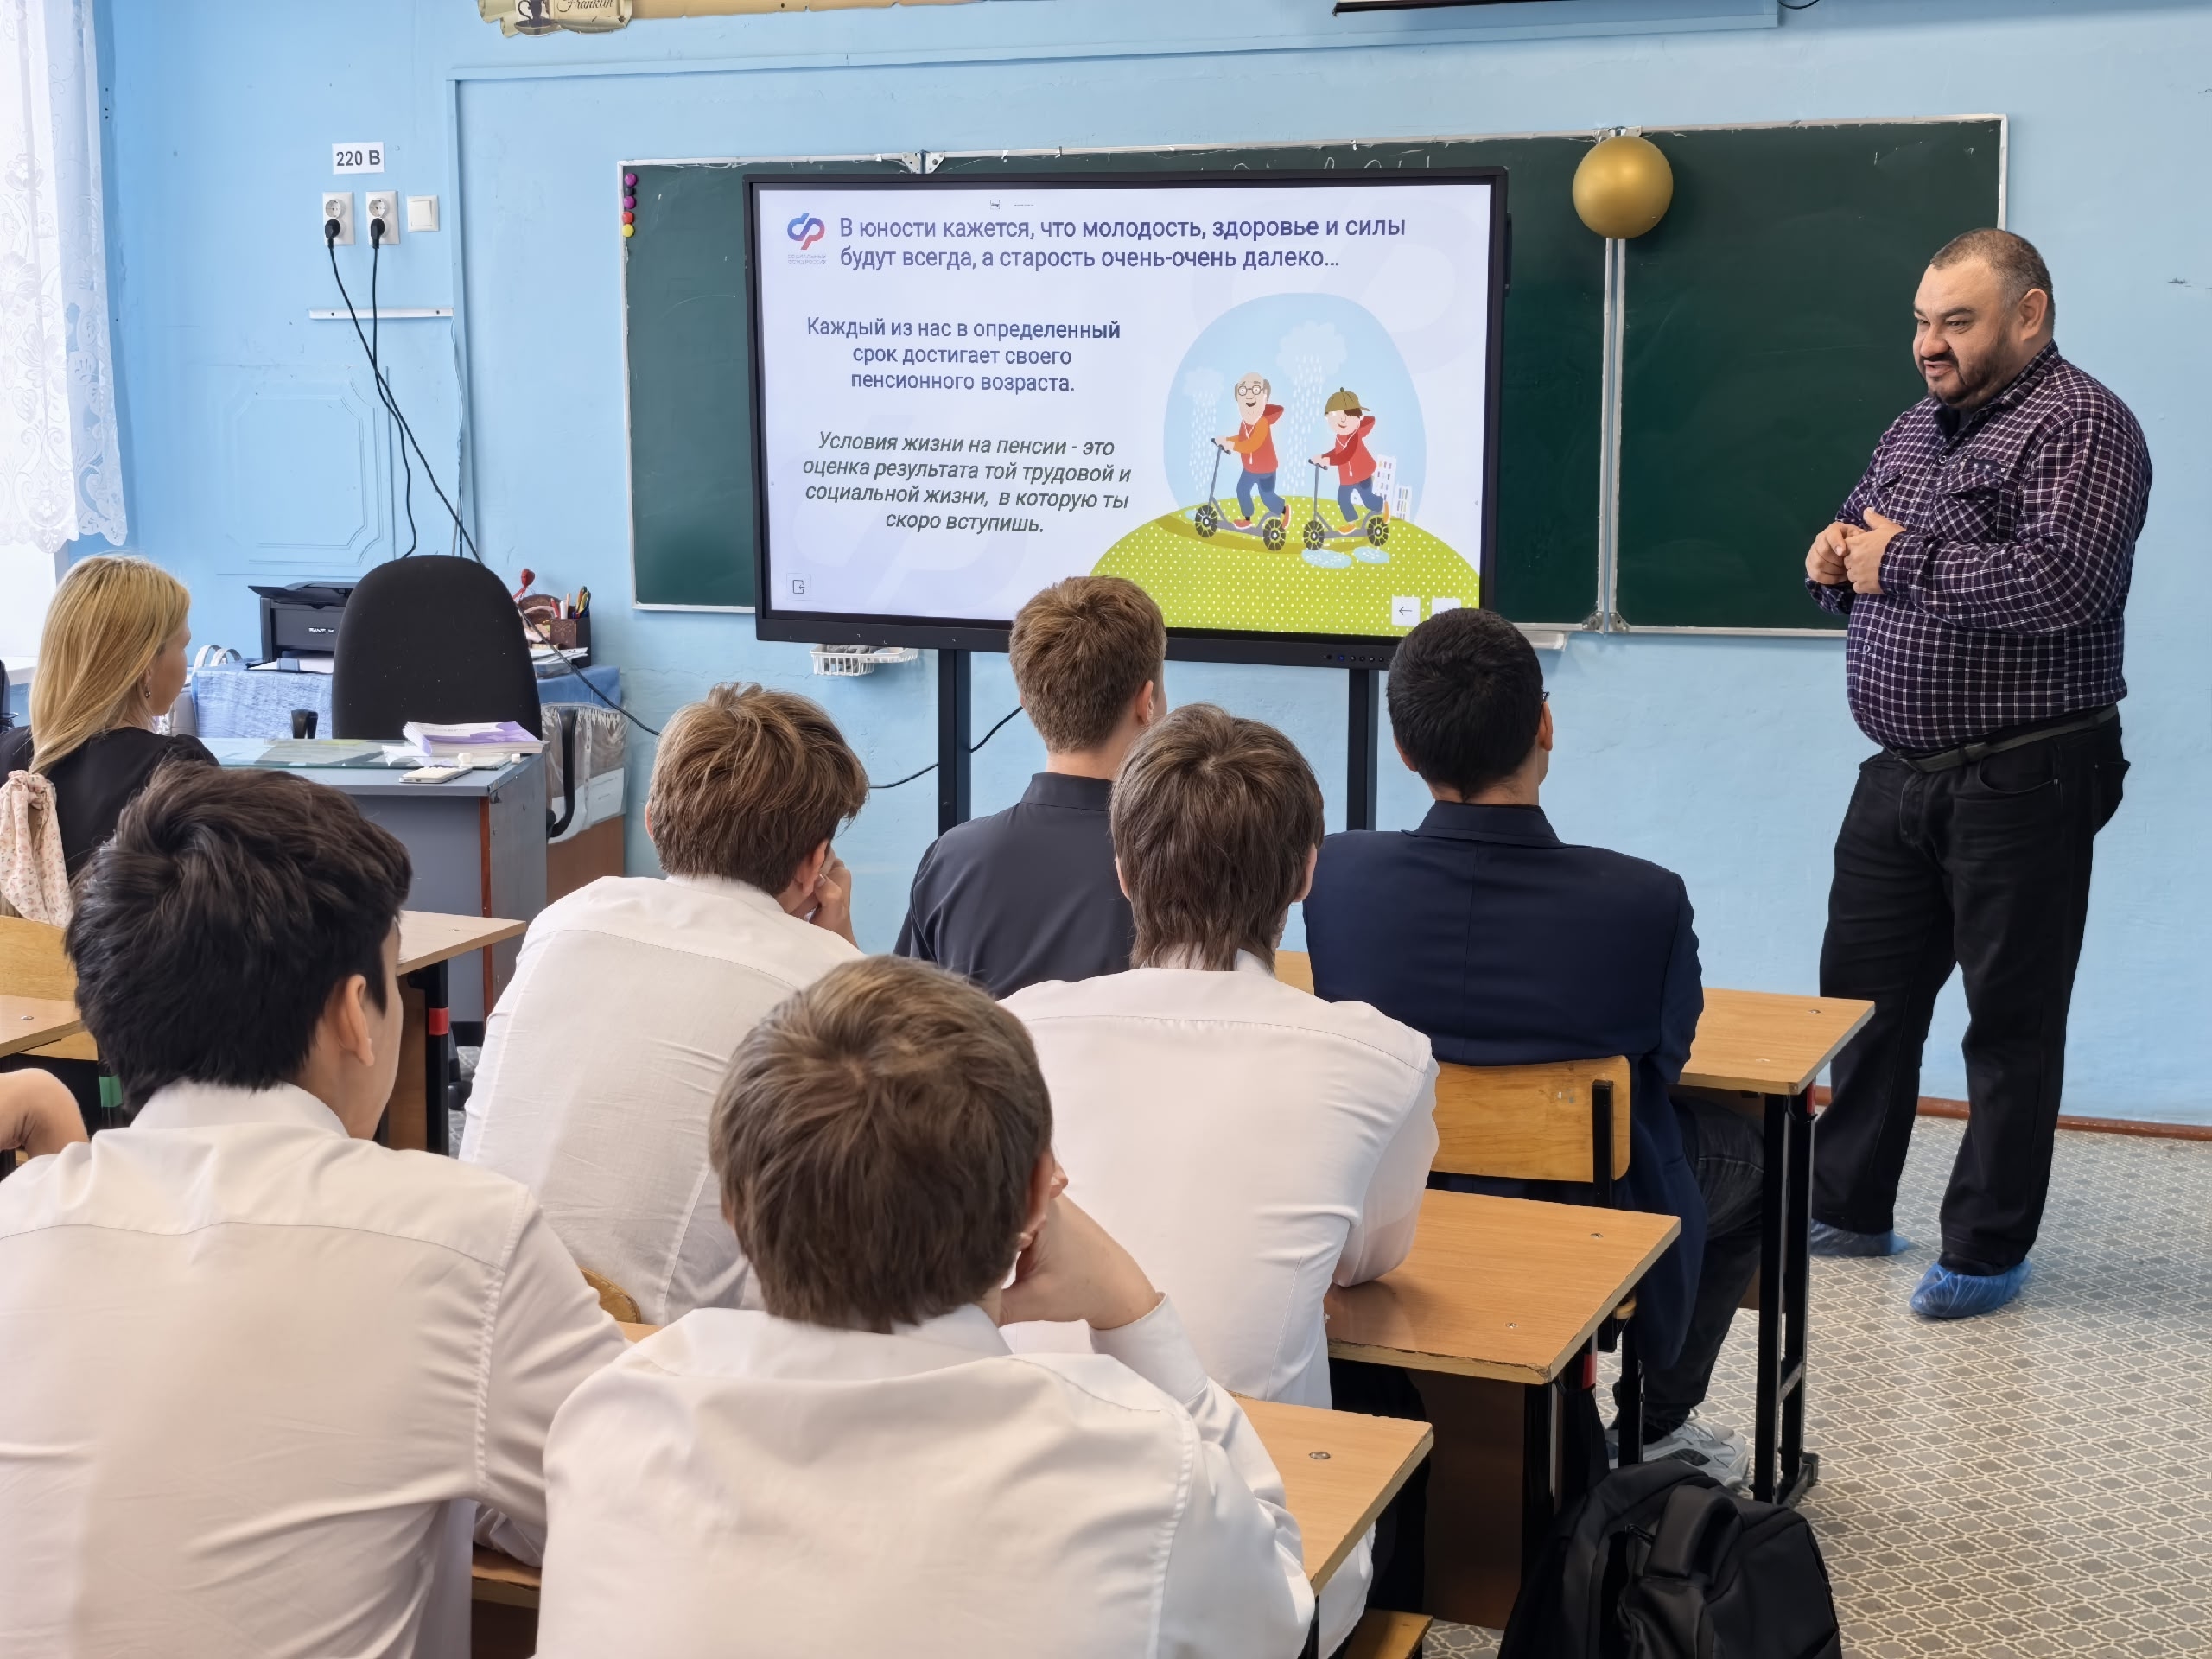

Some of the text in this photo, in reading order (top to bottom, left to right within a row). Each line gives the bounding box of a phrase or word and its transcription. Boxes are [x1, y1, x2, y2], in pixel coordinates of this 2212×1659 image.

[336, 150, 380, 166] 220 В
[840, 217, 1406, 242] В юности кажется, что молодость, здоровье и силы
[840, 245, 897, 271] будут
[902, 251, 976, 270] всегда,
[982, 251, 994, 267] а
[999, 251, 1096, 272] старость
[1101, 251, 1237, 268] очень-очень
[807, 316, 1121, 342] Каждый из нас в определенный
[852, 347, 1072, 366] срок достигает своего
[851, 373, 1075, 396] пенсионного возраста.
[818, 430, 899, 451] Условия
[900, 437, 964, 453] жизни
[968, 439, 992, 454] на
[996, 439, 1067, 455] пенсии
[1082, 442, 1116, 456] это
[803, 460, 1132, 486] оценка результата той трудовой и
[805, 485, 1129, 512] социальной жизни, в которую ты
[886, 513, 1044, 536] скоро вступишь.
